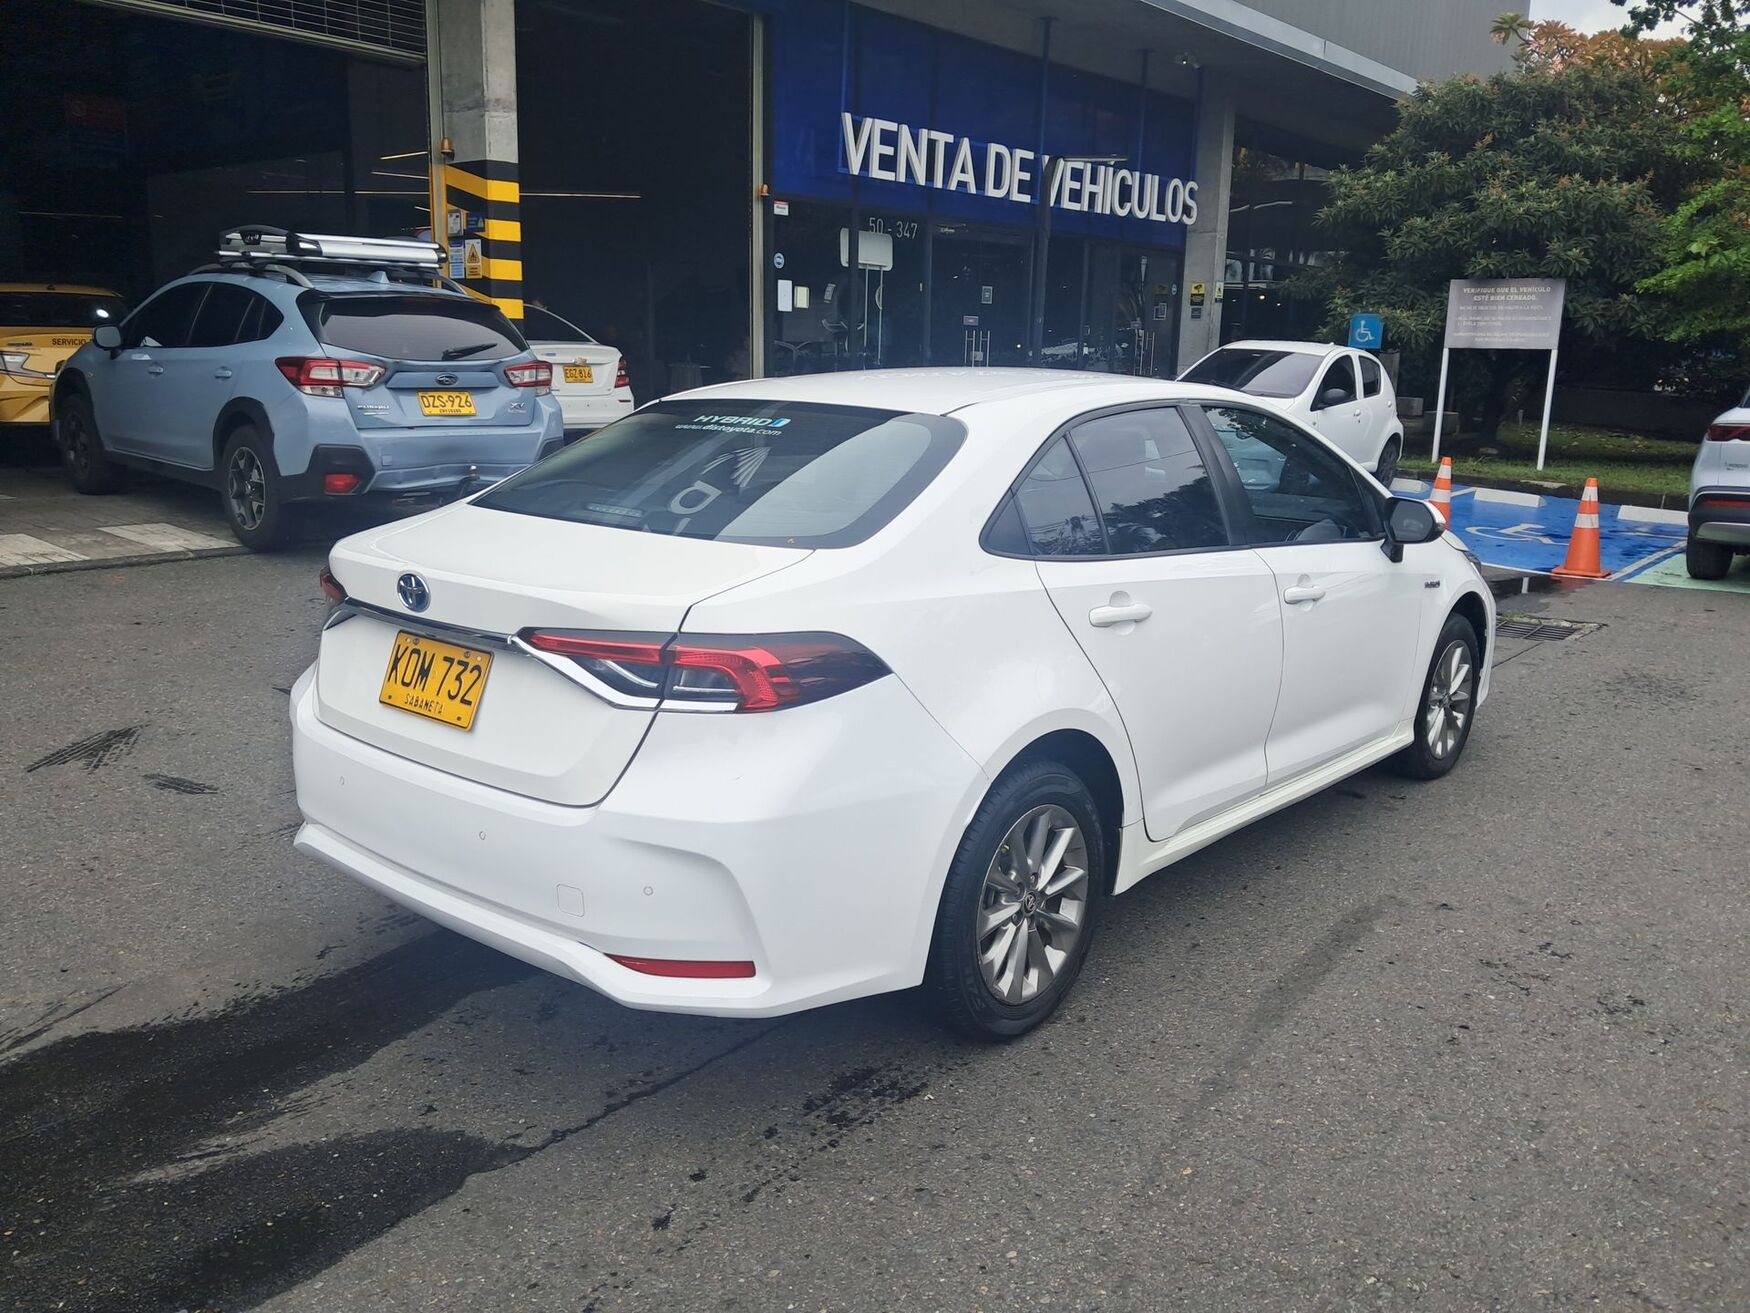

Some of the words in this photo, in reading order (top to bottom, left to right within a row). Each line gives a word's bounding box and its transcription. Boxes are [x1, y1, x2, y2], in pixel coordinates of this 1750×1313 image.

[841, 112, 977, 195] VENTA
[984, 142, 1035, 204] DE
[869, 217, 884, 234] 50
[896, 221, 918, 239] 347
[51, 338, 86, 346] SERVICIO
[675, 424, 782, 436] www.distoyota.com
[693, 415, 773, 426] HYBRID
[387, 644, 436, 692] KOM
[436, 655, 482, 706] 732
[404, 693, 444, 714] SABANETA
